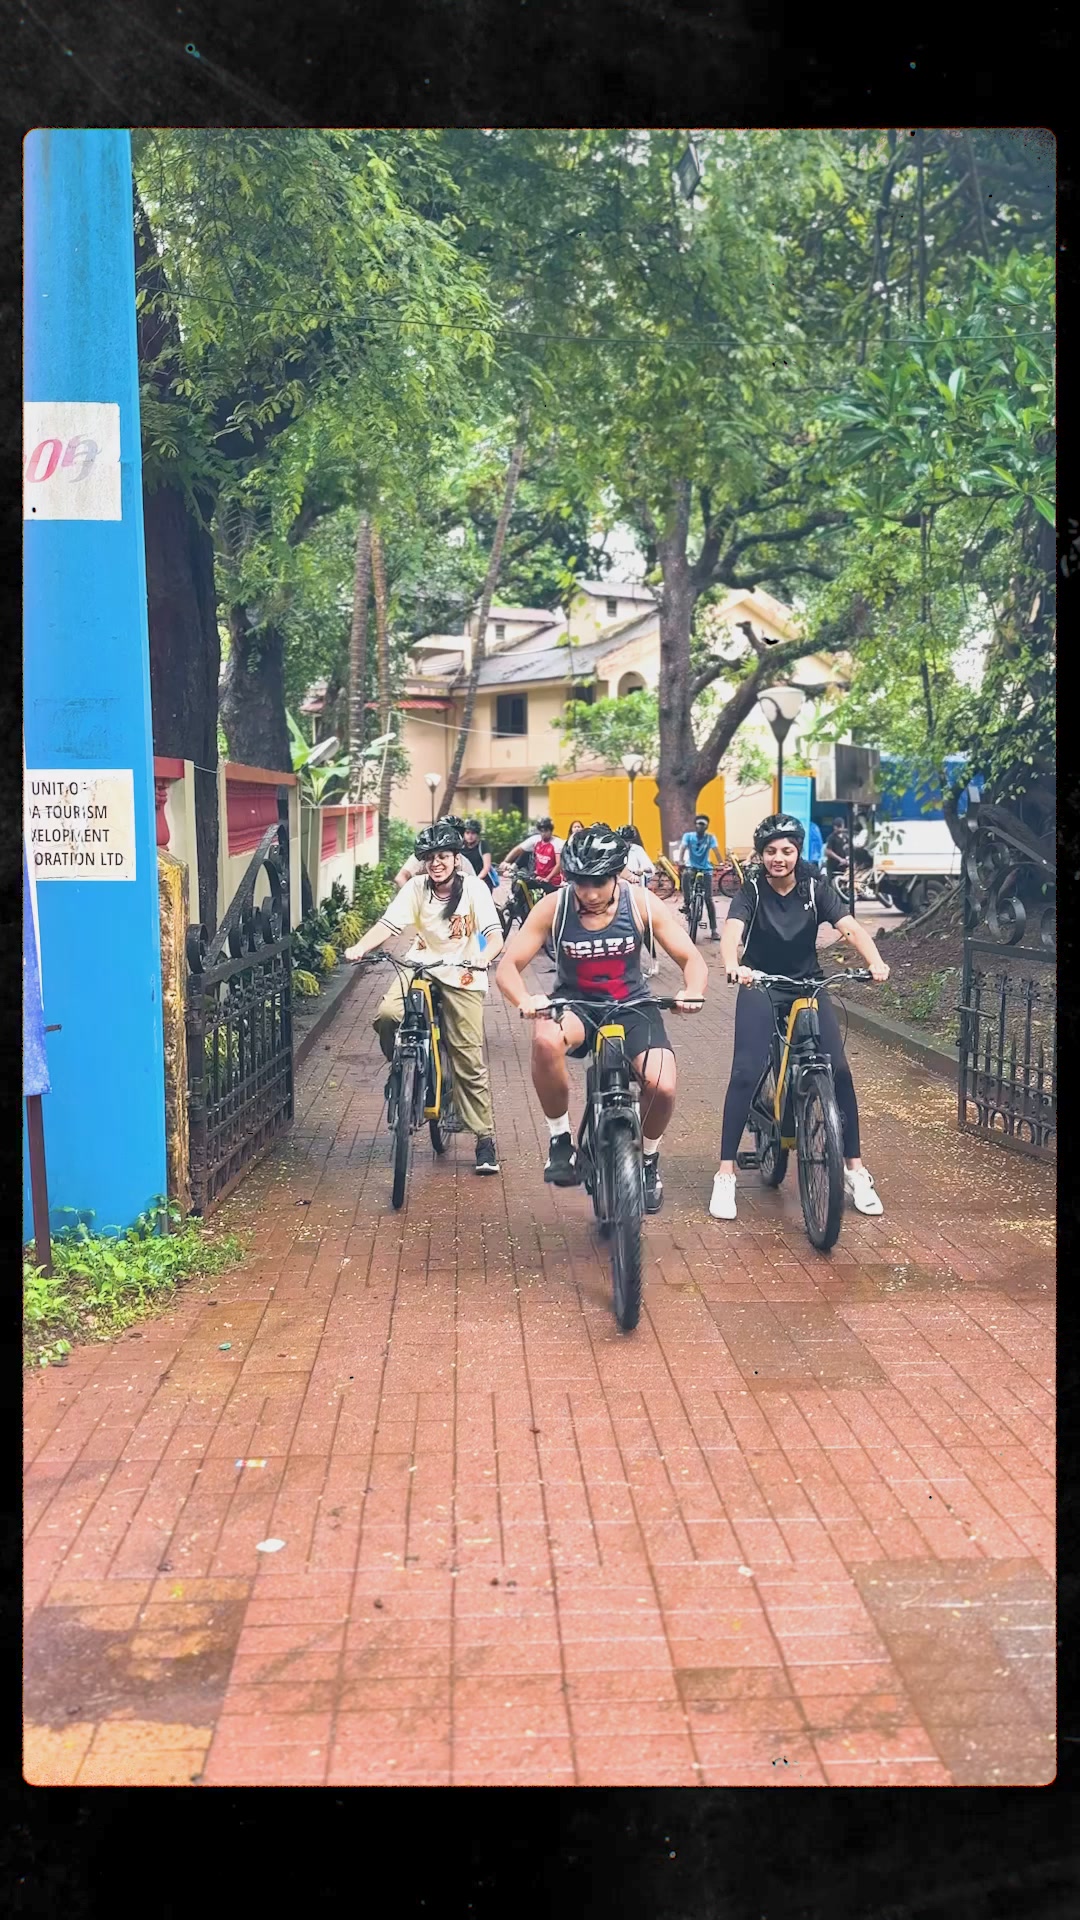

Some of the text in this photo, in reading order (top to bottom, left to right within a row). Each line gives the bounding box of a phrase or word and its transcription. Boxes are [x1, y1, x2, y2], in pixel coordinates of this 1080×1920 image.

[31, 781, 64, 796] UNIT
[29, 805, 108, 819] A TOURISM
[34, 852, 124, 866] ORATION LTD
